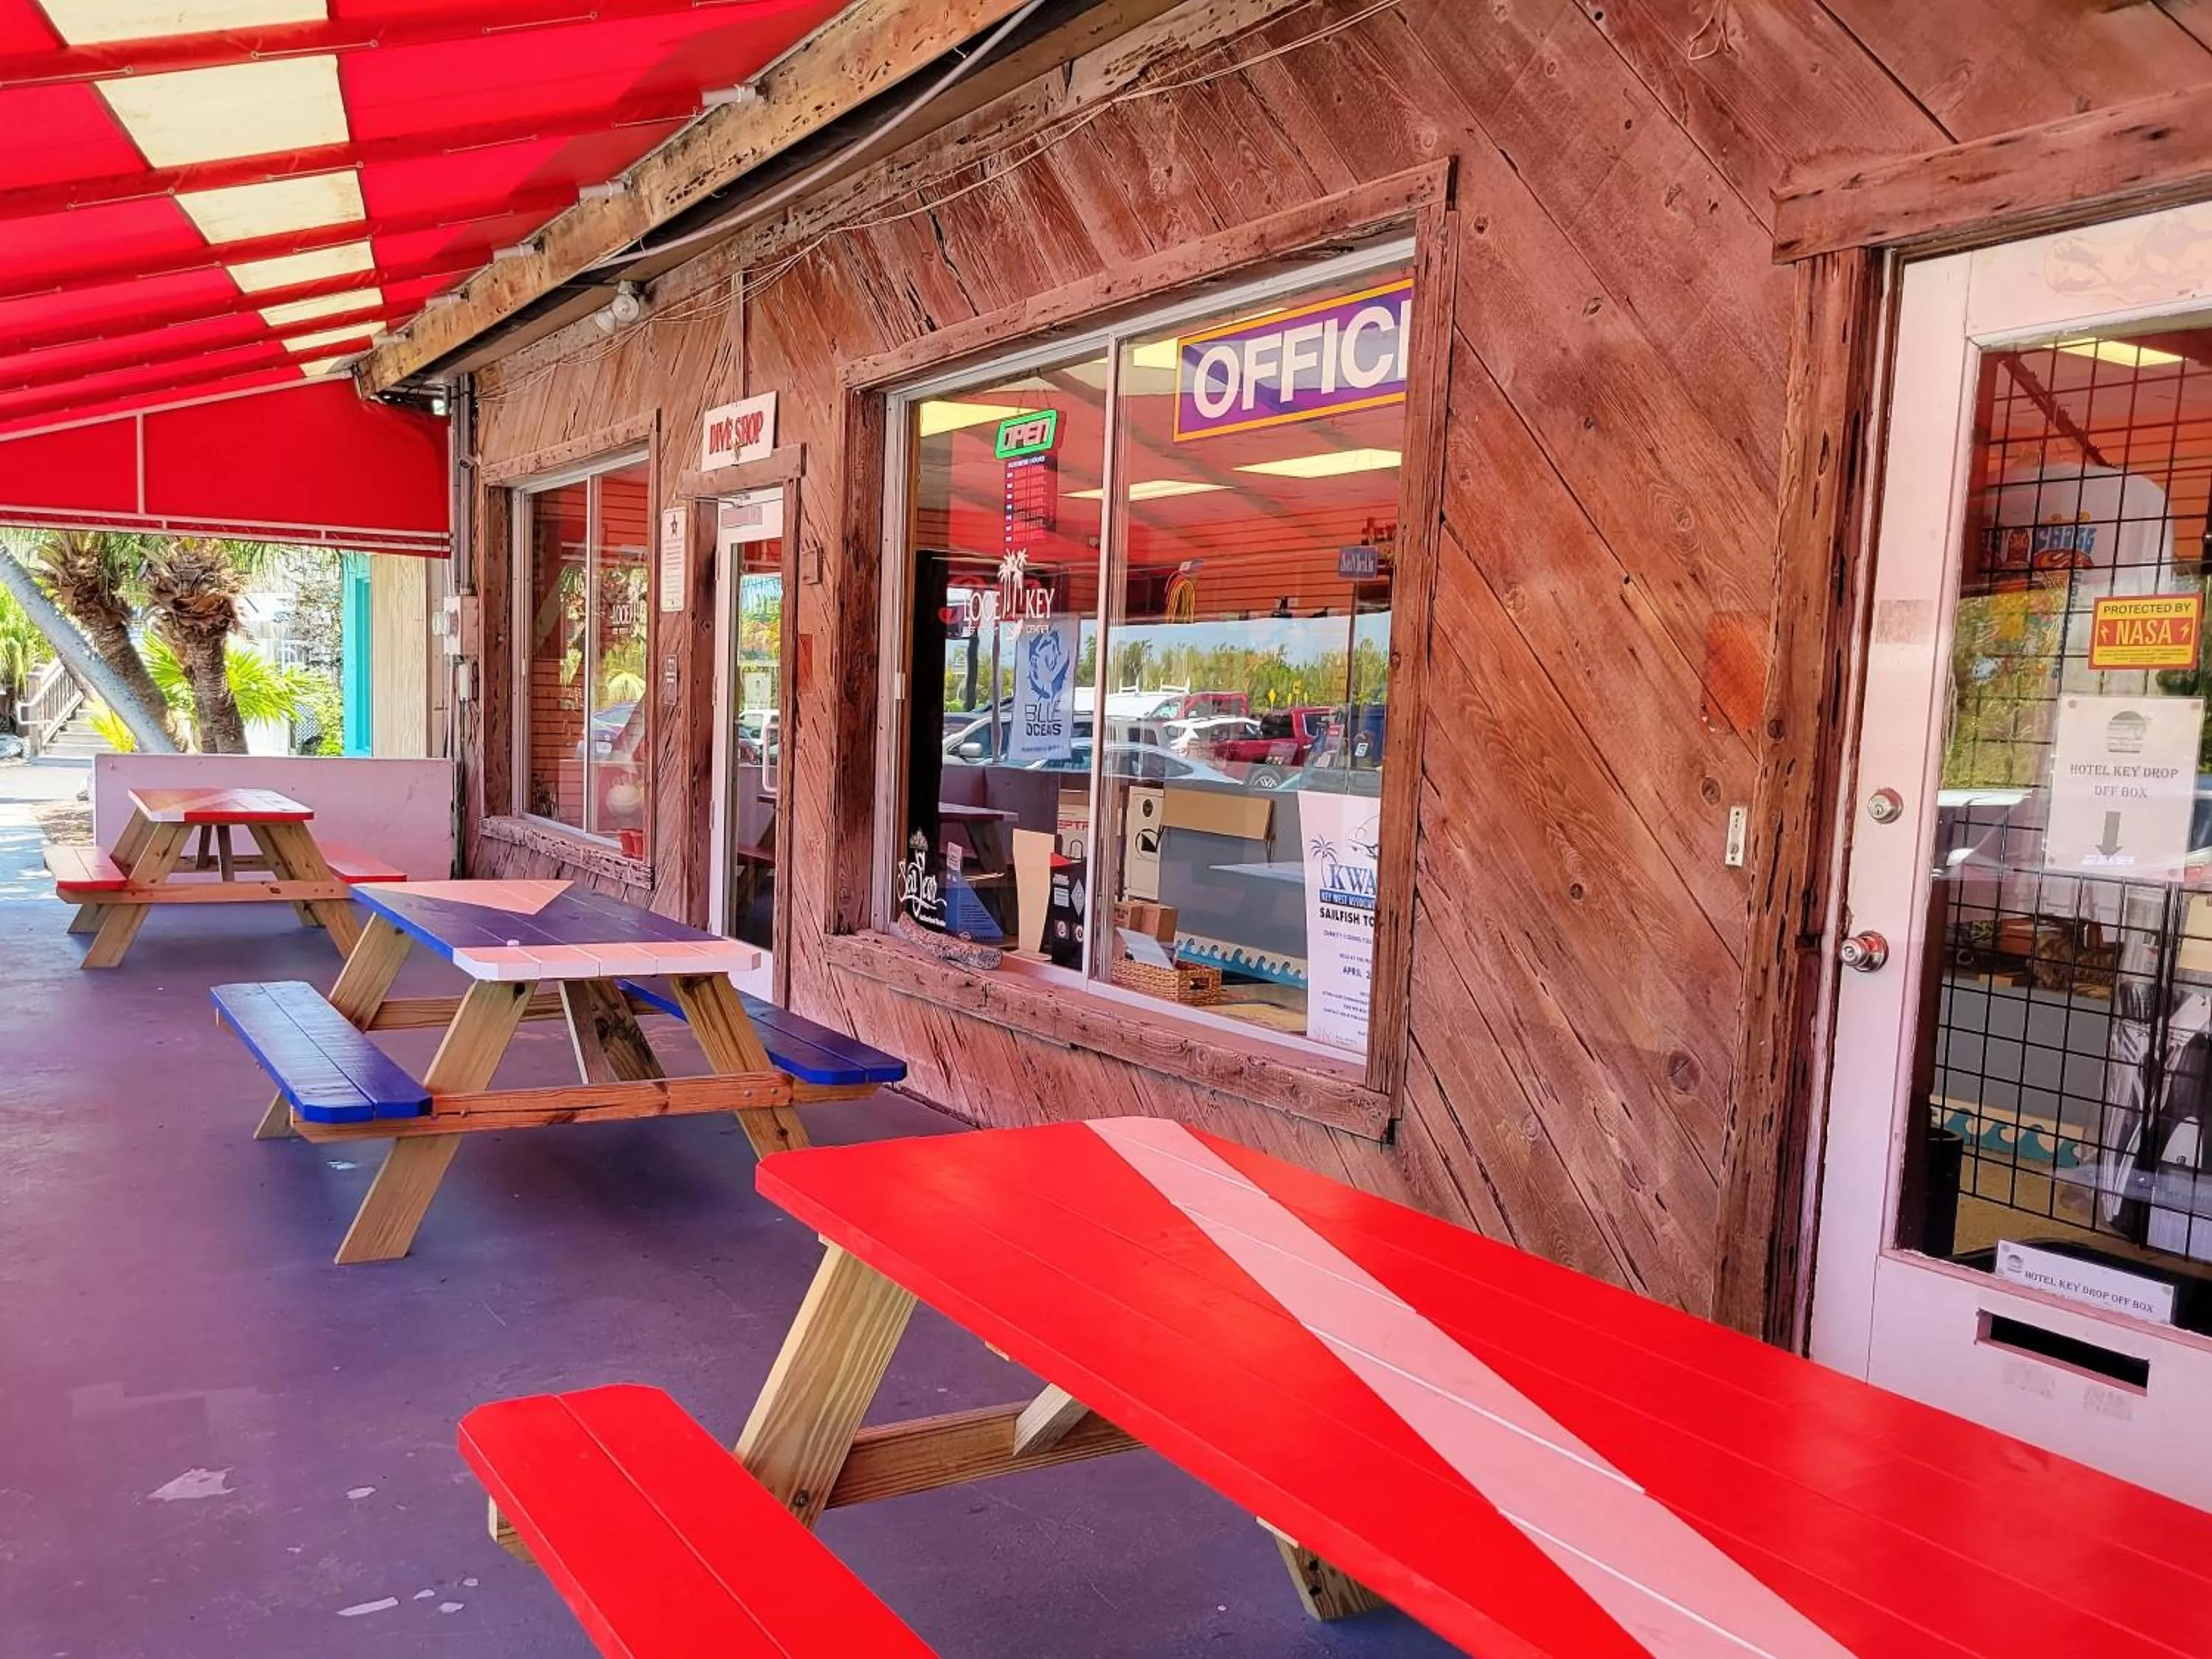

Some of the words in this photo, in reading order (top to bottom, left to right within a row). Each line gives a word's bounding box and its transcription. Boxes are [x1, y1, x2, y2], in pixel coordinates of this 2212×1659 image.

[1194, 299, 1411, 418] OFFIC
[709, 417, 733, 454] DIVE
[734, 411, 763, 447] SHOP
[1003, 418, 1051, 451] OPEN
[1026, 588, 1054, 619] KEY
[2104, 602, 2172, 614] PROTECTED
[2174, 602, 2191, 613] BY
[2115, 619, 2172, 645] NASA
[2070, 763, 2110, 776] HOTEL
[2113, 765, 2140, 777] KEY
[2143, 767, 2179, 779] DROP
[2094, 785, 2118, 796] OFF
[2121, 787, 2147, 799] BOX
[1319, 907, 1360, 925] SAILFISH
[2025, 1270, 2056, 1287] HOTEL
[2059, 1279, 2080, 1292] KEY
[2082, 1285, 2110, 1299] DROP
[2111, 1294, 2131, 1306] OFF
[2132, 1300, 2154, 1314] BOX
